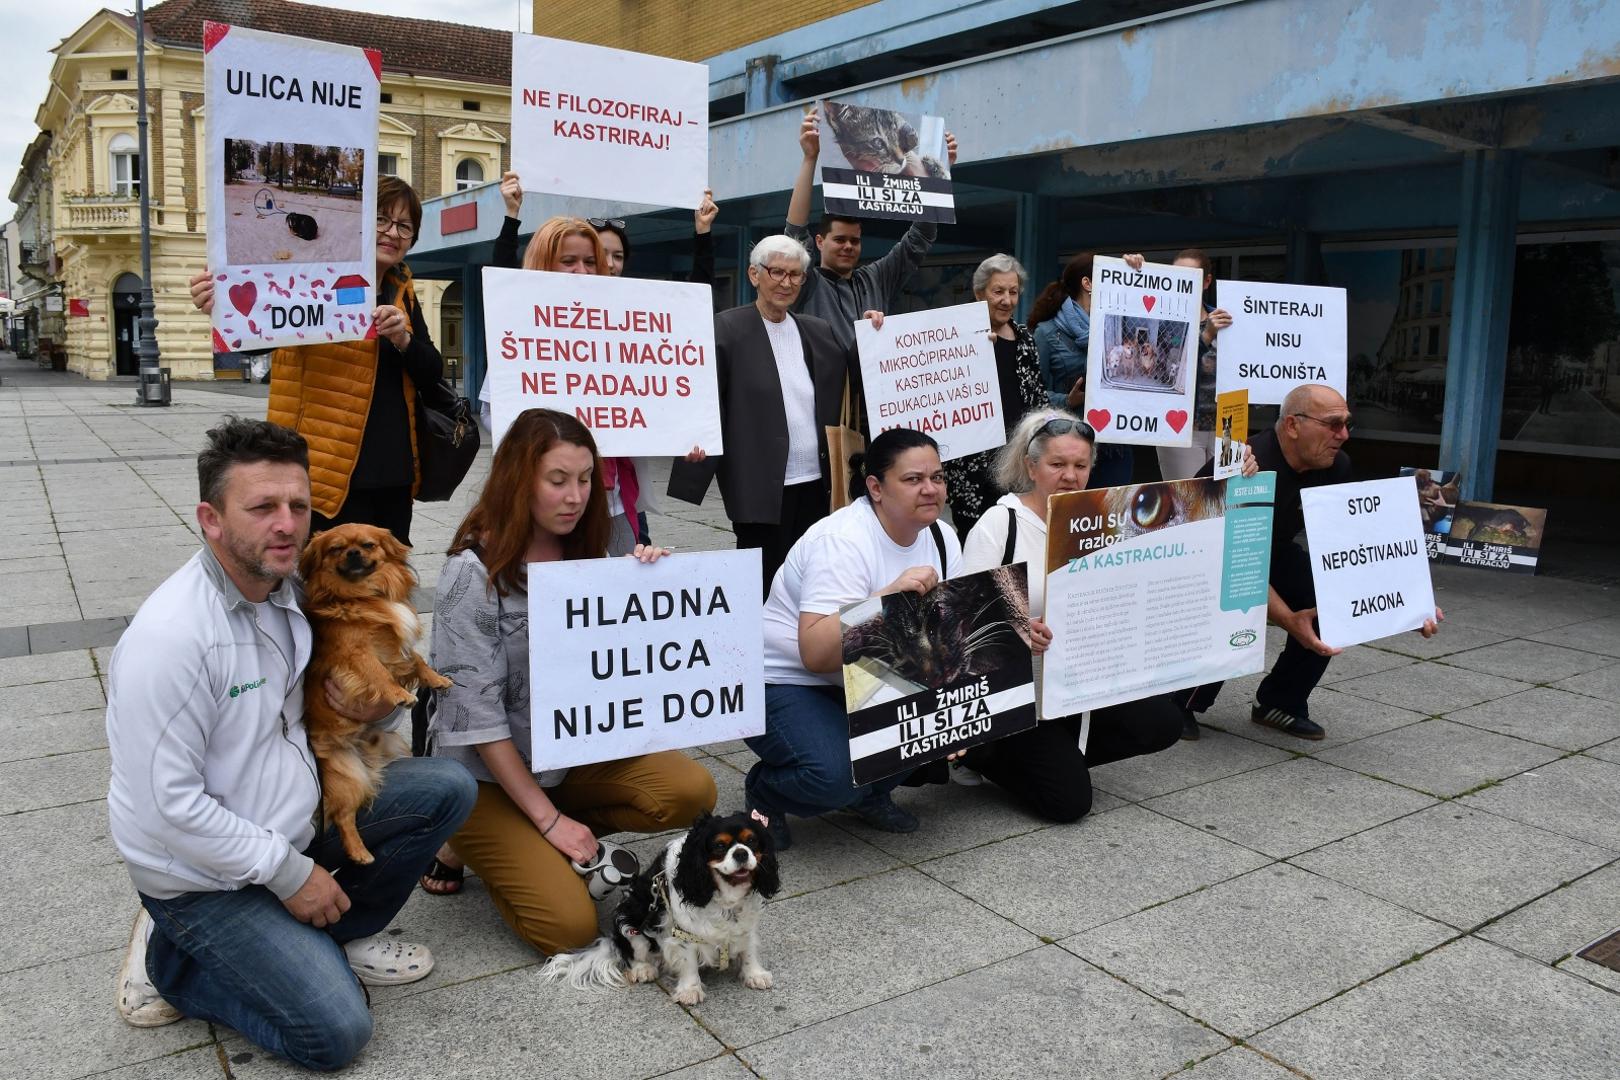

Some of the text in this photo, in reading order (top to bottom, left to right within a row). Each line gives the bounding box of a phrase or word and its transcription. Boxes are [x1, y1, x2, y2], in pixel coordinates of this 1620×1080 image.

[227, 69, 362, 109] ULICA NIJE
[523, 88, 550, 108] NE
[558, 93, 682, 126] FILOZOFIRAJ
[554, 120, 669, 150] KASTRIRAJ!
[856, 175, 921, 191] ILI ŽMIRIŠ
[858, 186, 923, 205] ILI SI ZA
[858, 201, 923, 214] KASTRACIJU
[1101, 269, 1193, 294] PRUŽIMO IM
[271, 303, 324, 330] DOM
[534, 301, 671, 333] NEŽELJENI
[1244, 296, 1322, 317] ŠINTERAJI
[501, 331, 704, 366] ŠTENCI I MAČIĆI
[895, 326, 959, 349] KONTROLA
[1266, 332, 1301, 348] NISU
[879, 343, 978, 374] MIKROČIPIRANJA,
[1239, 362, 1327, 380] SKLONIŠTA
[521, 372, 691, 397] NE PADAJU S
[895, 365, 971, 392] KASTRACIJA I
[879, 381, 989, 418] EDUKACIJA VAŠI SU
[576, 406, 647, 429] NEBA
[952, 401, 994, 427] ADUTI
[1116, 414, 1158, 432] DOM
[1348, 496, 1381, 515] STOP
[1070, 512, 1128, 534] KOJI SU
[1322, 539, 1418, 571] NEPOŠTIVANJU
[1462, 541, 1513, 554] ILI ŽMIRIŠ
[1462, 548, 1510, 562] ILI SI ZA
[1068, 557, 1089, 574] ZA
[1461, 557, 1510, 568] KASTRACIJU
[566, 586, 730, 629] HLADNA
[1351, 591, 1405, 617] ZAKONA
[591, 639, 711, 680] ULICA
[553, 683, 743, 740] NIJE DOM
[897, 675, 990, 722] ILI ŽMIRIŠ
[899, 698, 990, 743] ILI SI ZA
[899, 717, 992, 760] KASTRACIJU
